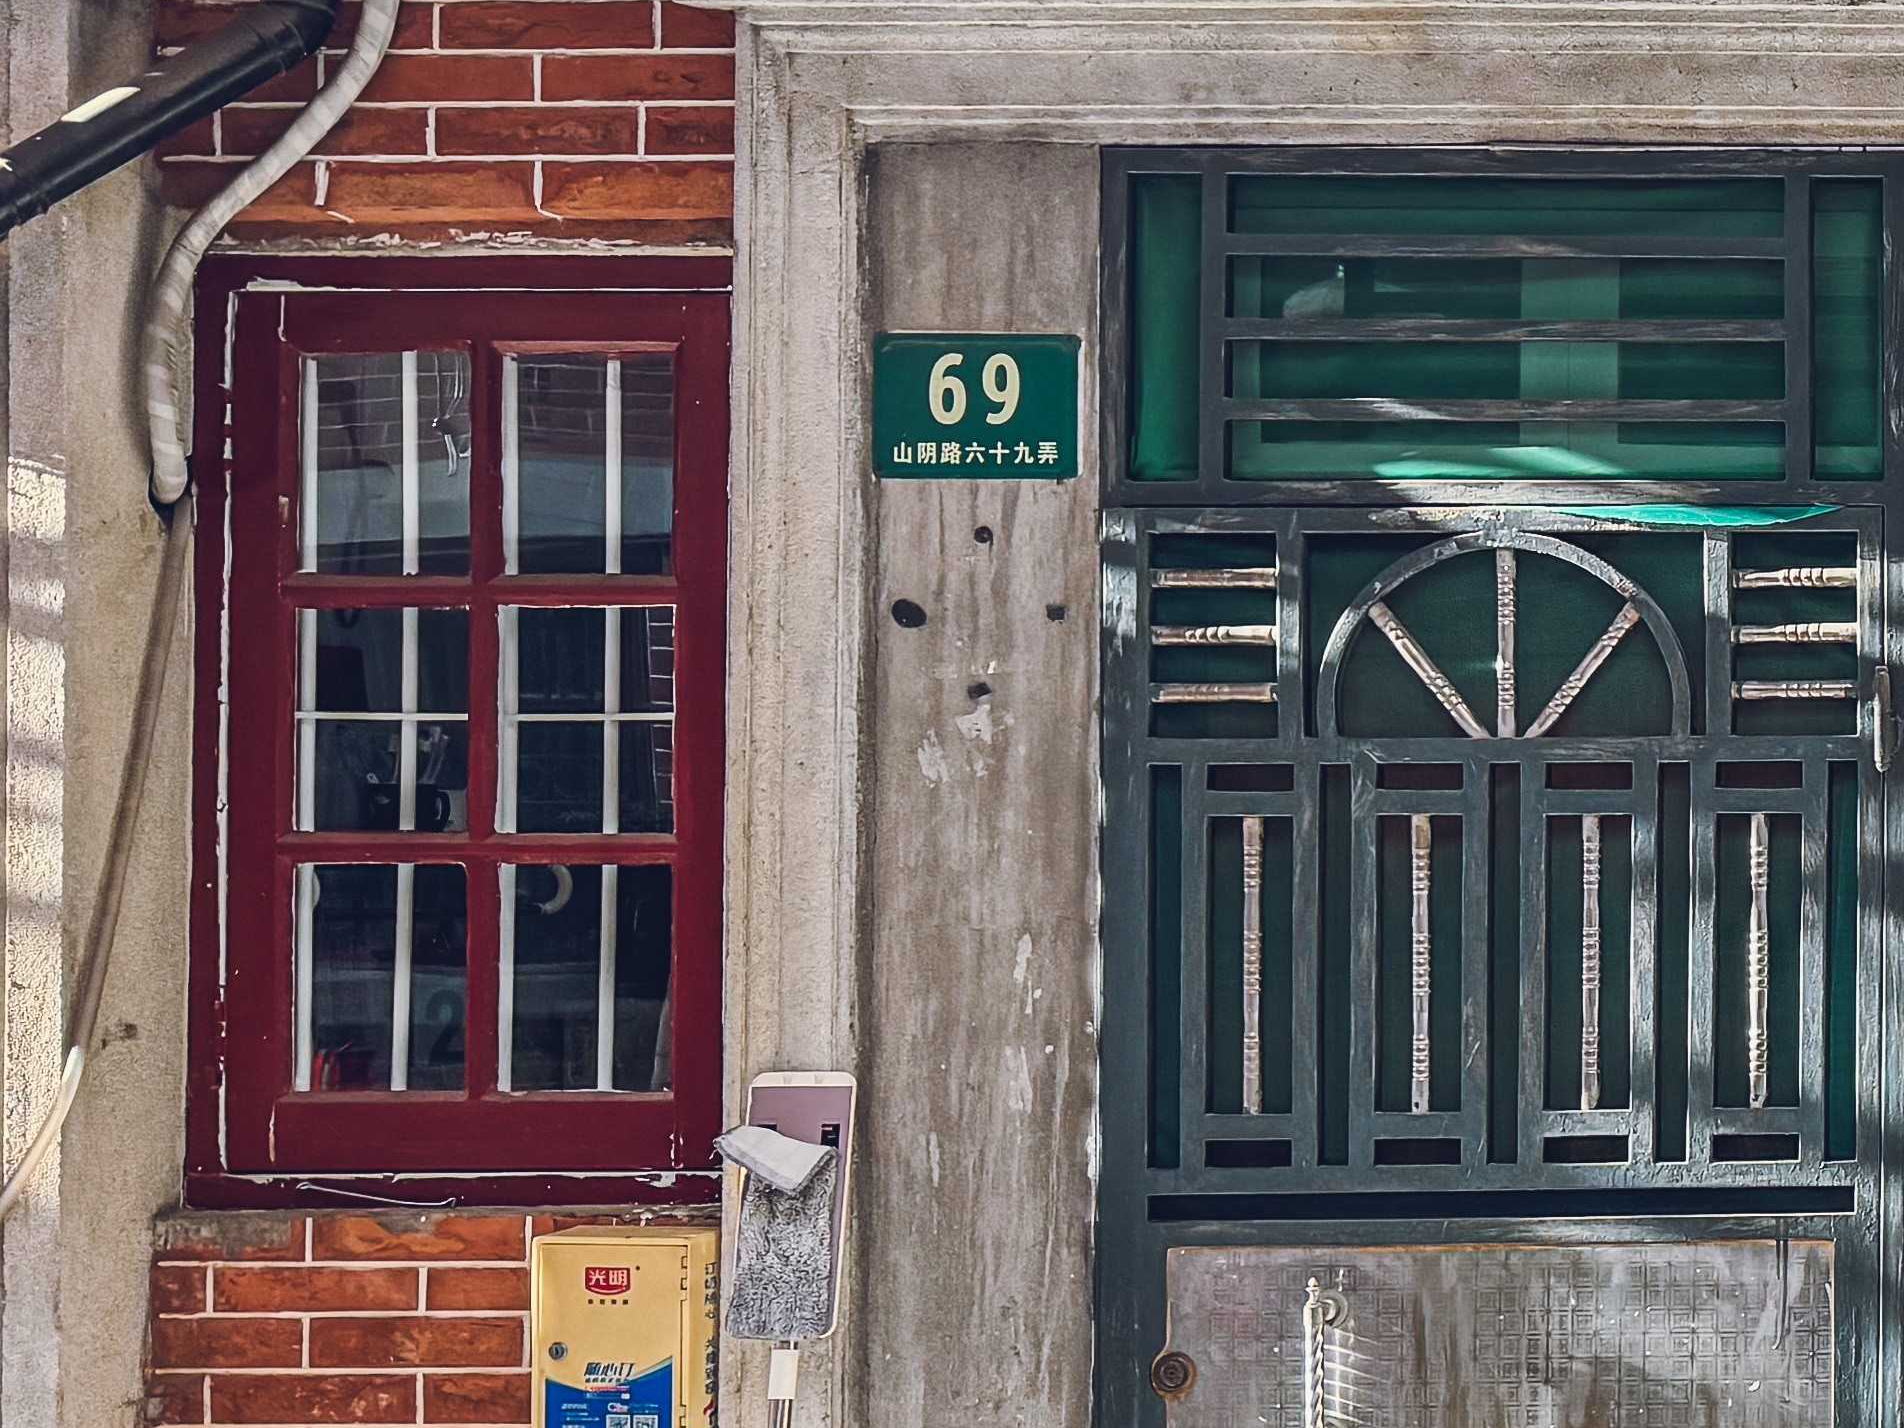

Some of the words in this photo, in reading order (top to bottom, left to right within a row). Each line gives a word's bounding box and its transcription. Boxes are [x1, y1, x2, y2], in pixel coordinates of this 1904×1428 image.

[928, 352, 1021, 426] 69
[893, 441, 1059, 464] 山阴路六十九弄
[588, 1268, 629, 1287] 光明
